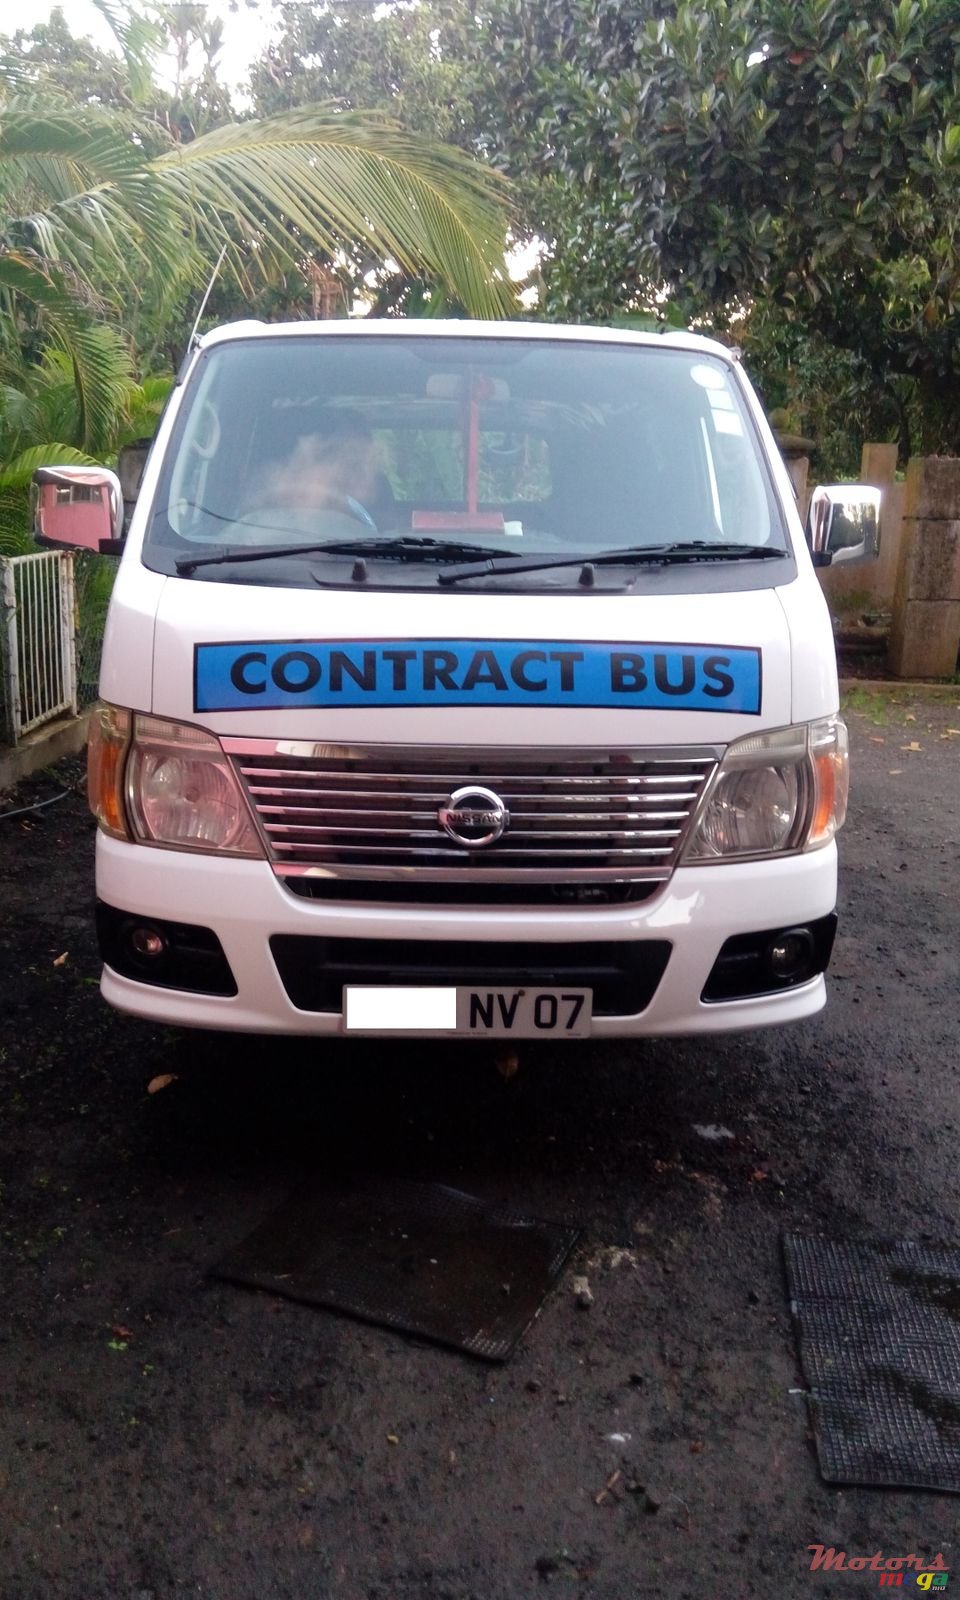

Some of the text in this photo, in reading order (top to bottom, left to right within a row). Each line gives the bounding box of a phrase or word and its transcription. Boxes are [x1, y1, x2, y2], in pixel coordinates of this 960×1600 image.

[229, 650, 735, 697] CONTRACT BUS
[470, 993, 585, 1030] NV 07
